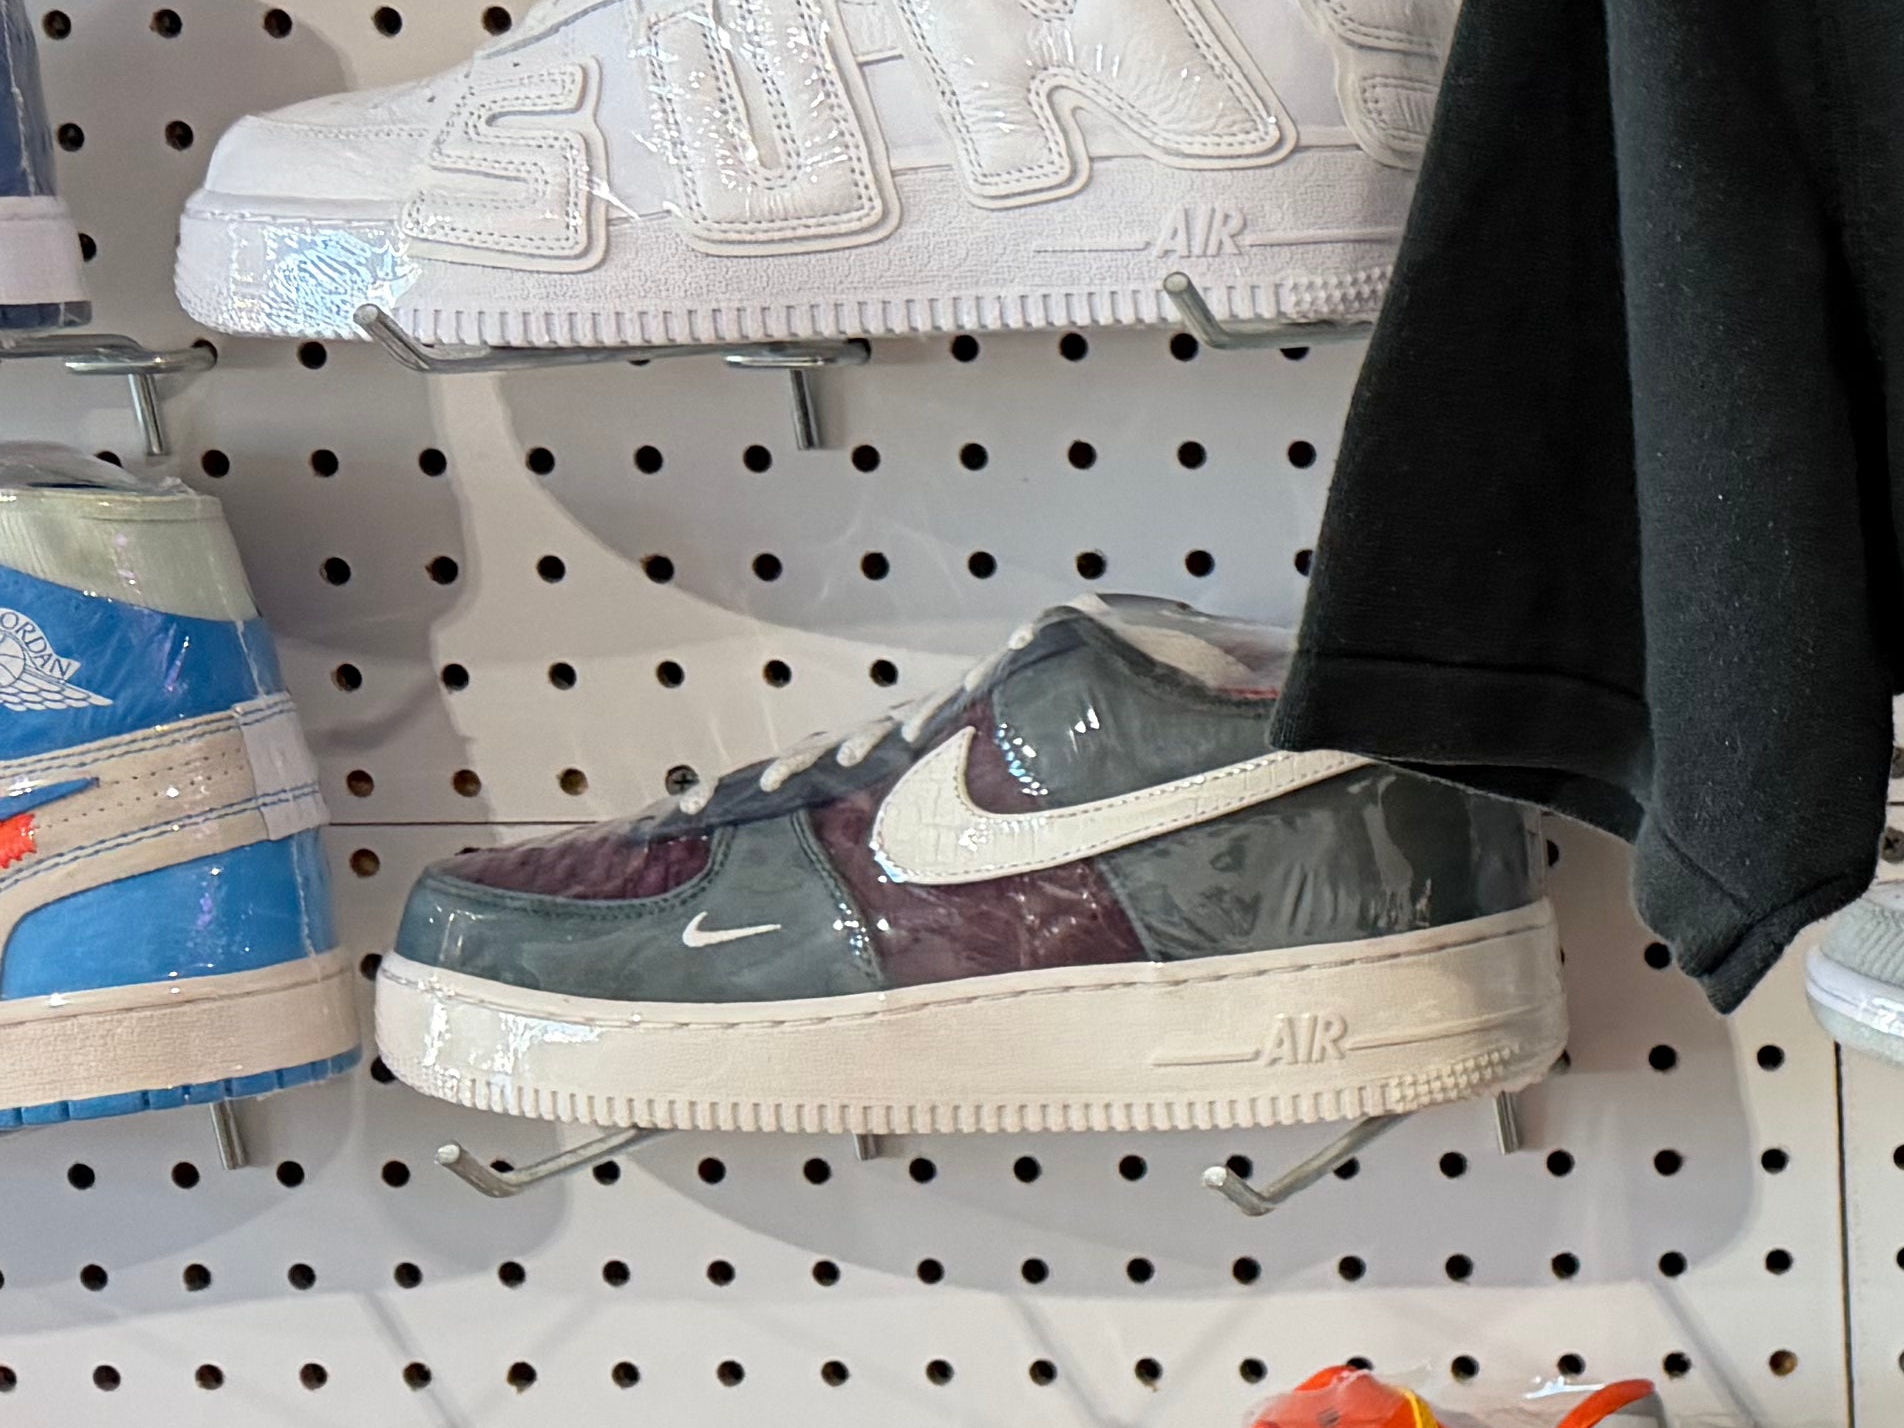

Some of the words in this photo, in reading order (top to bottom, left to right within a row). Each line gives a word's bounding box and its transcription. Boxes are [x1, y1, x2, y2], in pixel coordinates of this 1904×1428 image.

[1155, 204, 1248, 259] AIR
[0, 612, 72, 676] ORDAN
[1262, 1012, 1347, 1068] AIR
